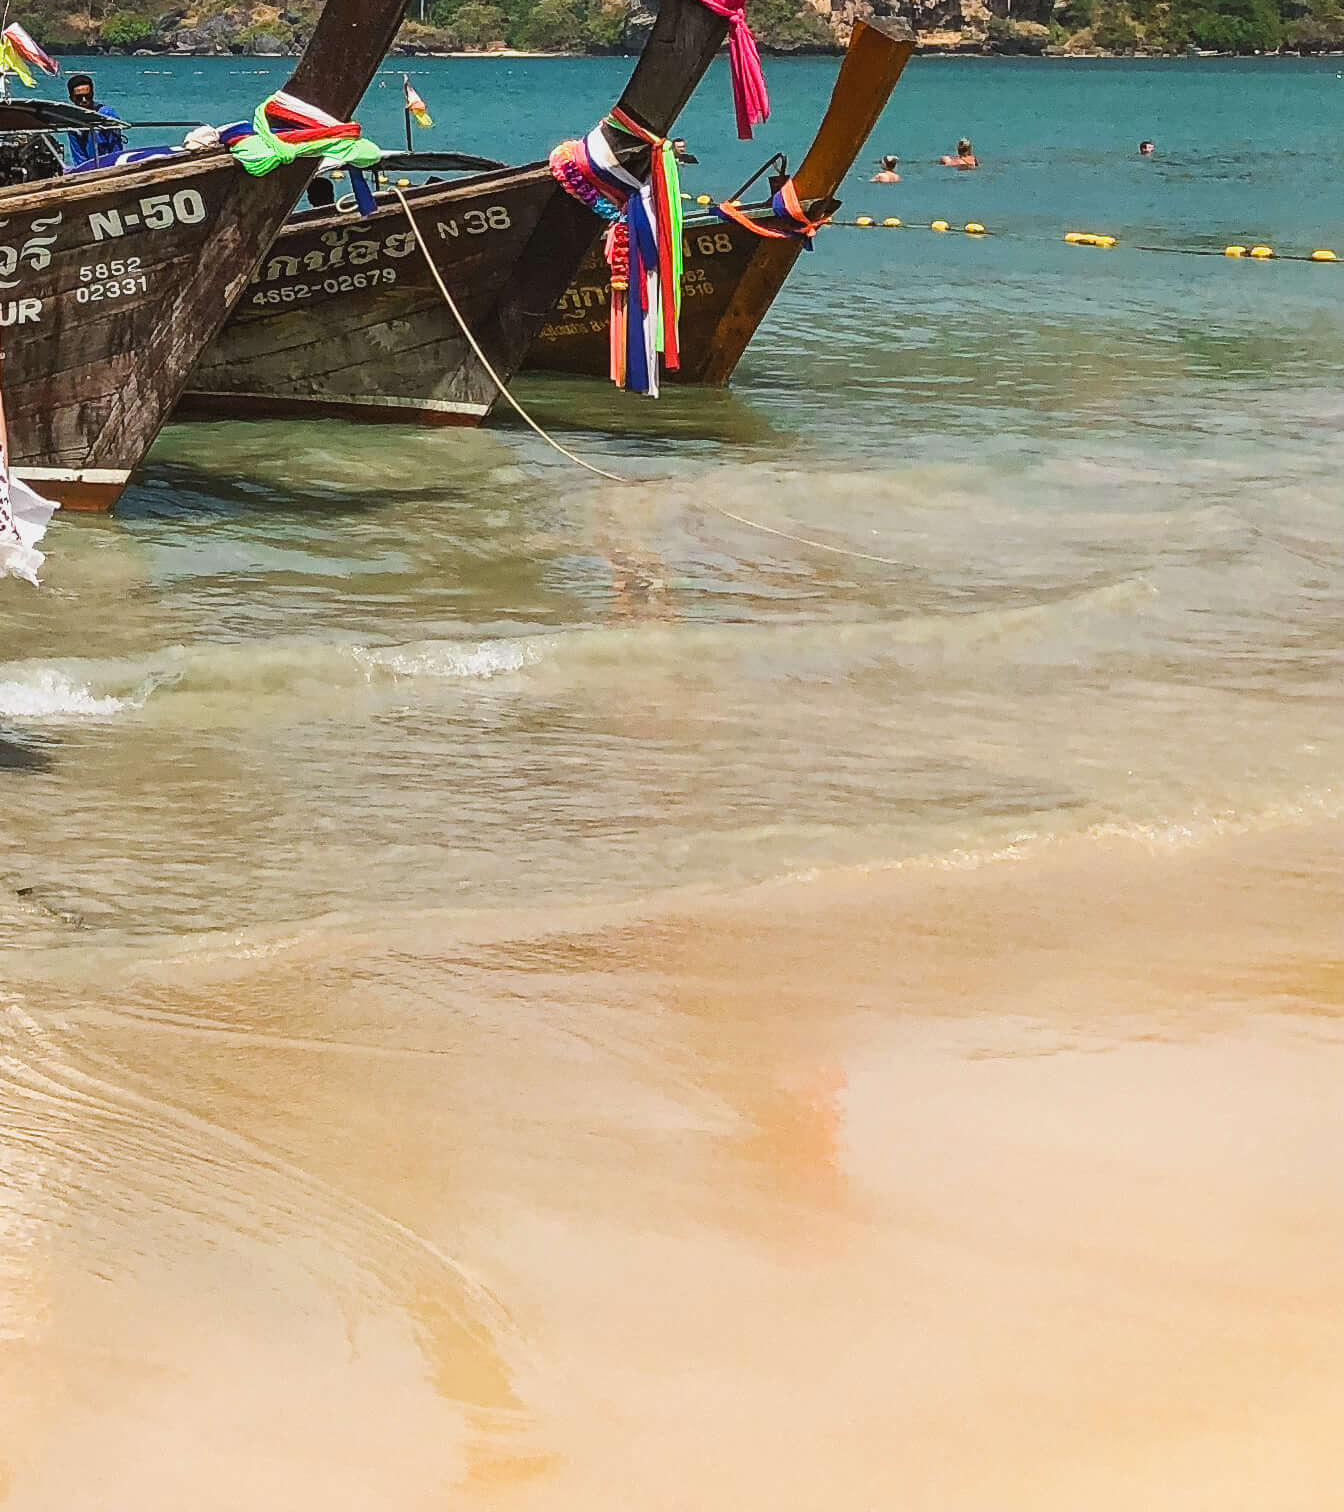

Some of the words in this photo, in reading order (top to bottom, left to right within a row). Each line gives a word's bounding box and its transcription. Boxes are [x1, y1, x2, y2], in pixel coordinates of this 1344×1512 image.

[89, 189, 206, 240] N-50
[463, 206, 511, 235] 38
[79, 257, 142, 282] 5852
[76, 276, 148, 303] 02331
